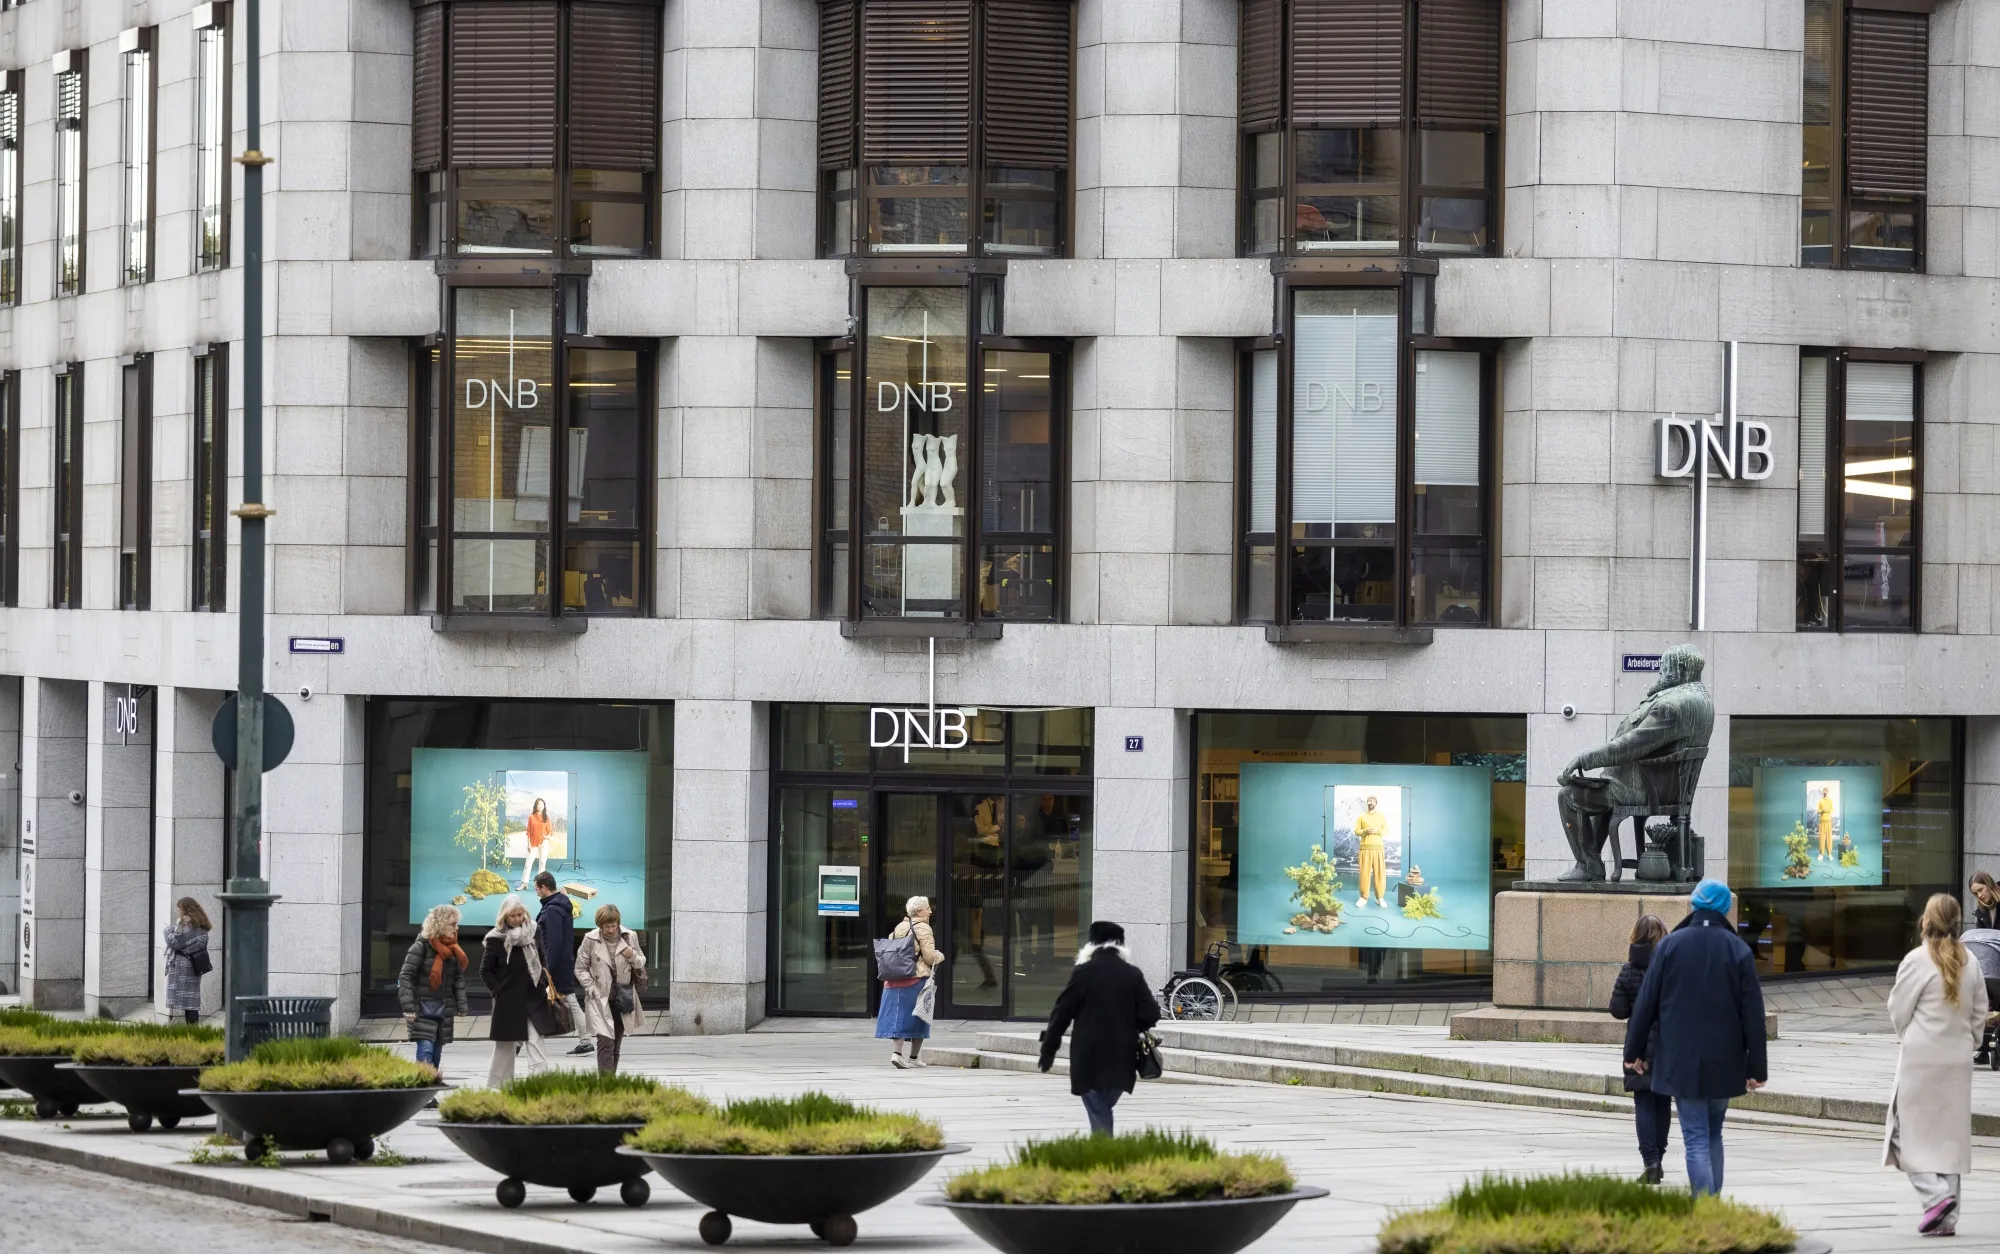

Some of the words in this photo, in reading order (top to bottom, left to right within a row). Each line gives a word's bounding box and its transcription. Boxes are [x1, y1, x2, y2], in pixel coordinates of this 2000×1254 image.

[466, 379, 538, 409] DNB
[877, 381, 953, 412] DNB
[1305, 381, 1383, 412] DNB
[1627, 657, 1662, 670] Arbeidergat
[116, 697, 137, 734] DNB
[869, 707, 968, 749] DNB
[1129, 738, 1140, 749] 27
